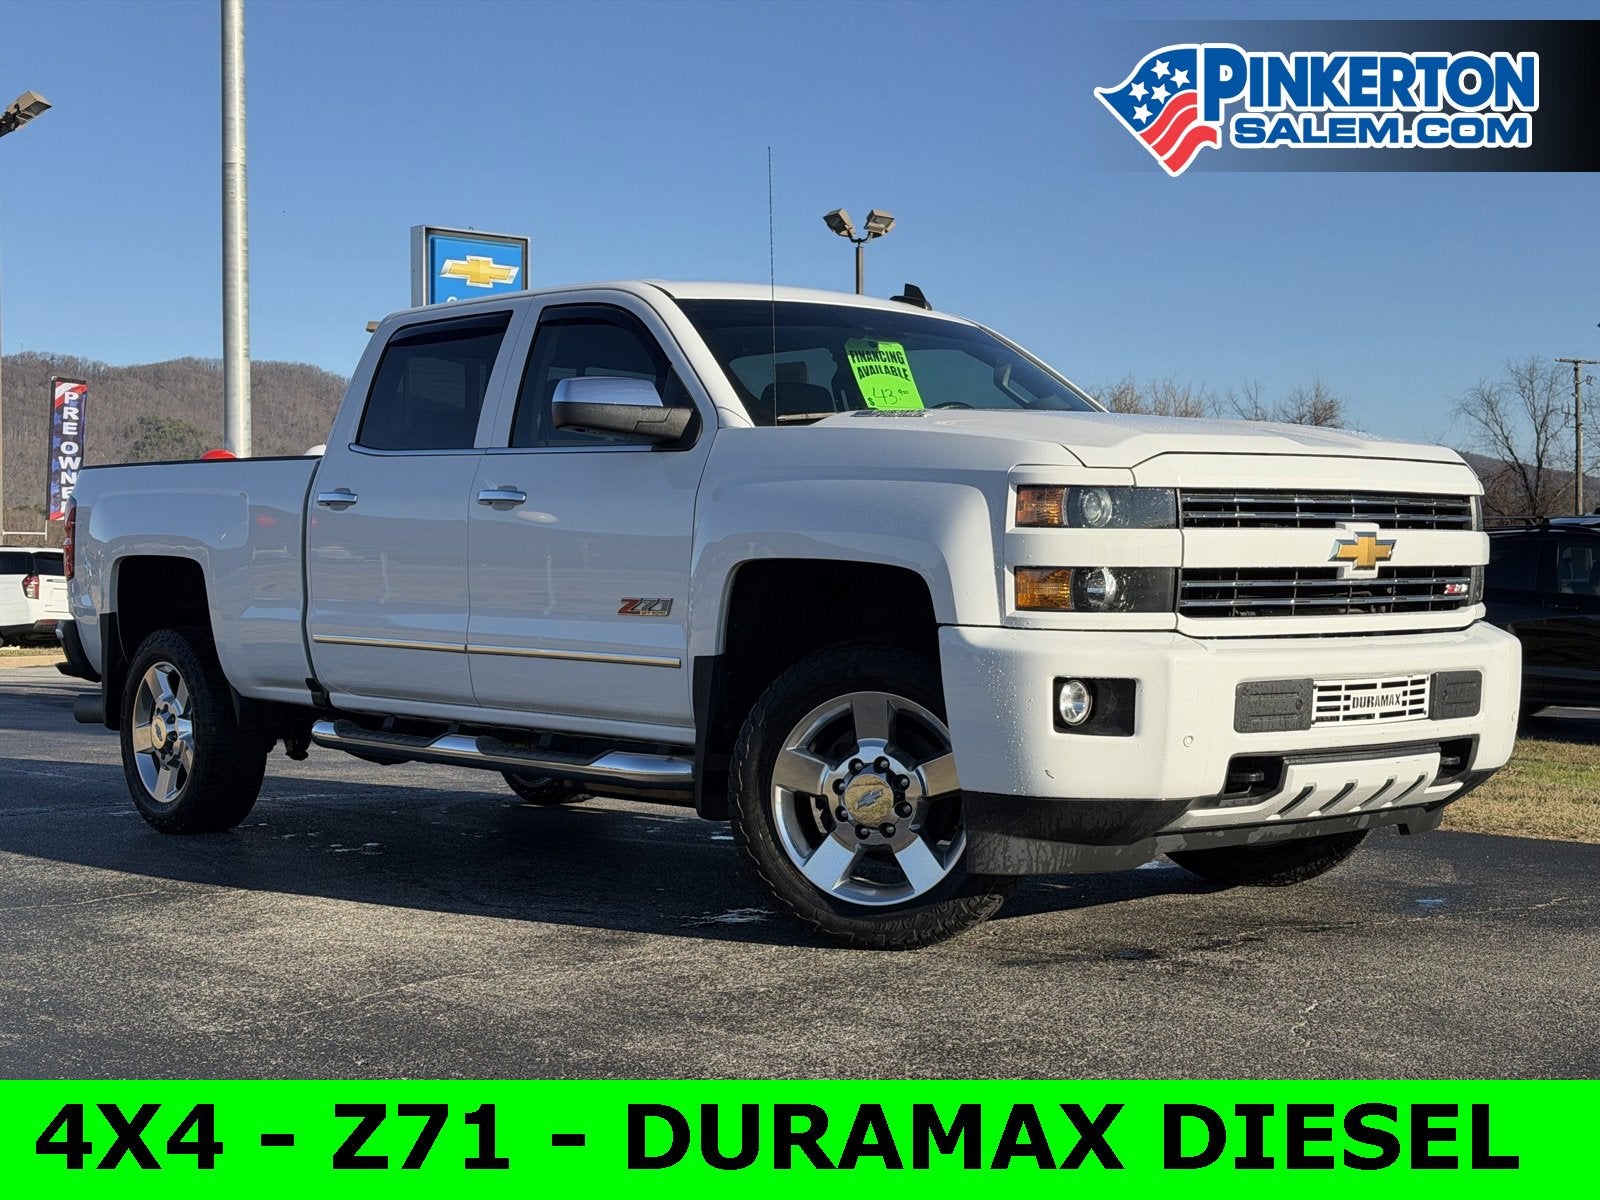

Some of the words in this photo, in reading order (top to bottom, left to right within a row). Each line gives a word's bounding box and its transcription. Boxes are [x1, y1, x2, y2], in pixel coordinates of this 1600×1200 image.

[848, 349, 905, 365] FINANCING
[857, 364, 911, 382] AVAILABLE
[62, 391, 79, 436] PRE
[617, 597, 674, 617] Z71
[1352, 693, 1401, 709] DURAMAX
